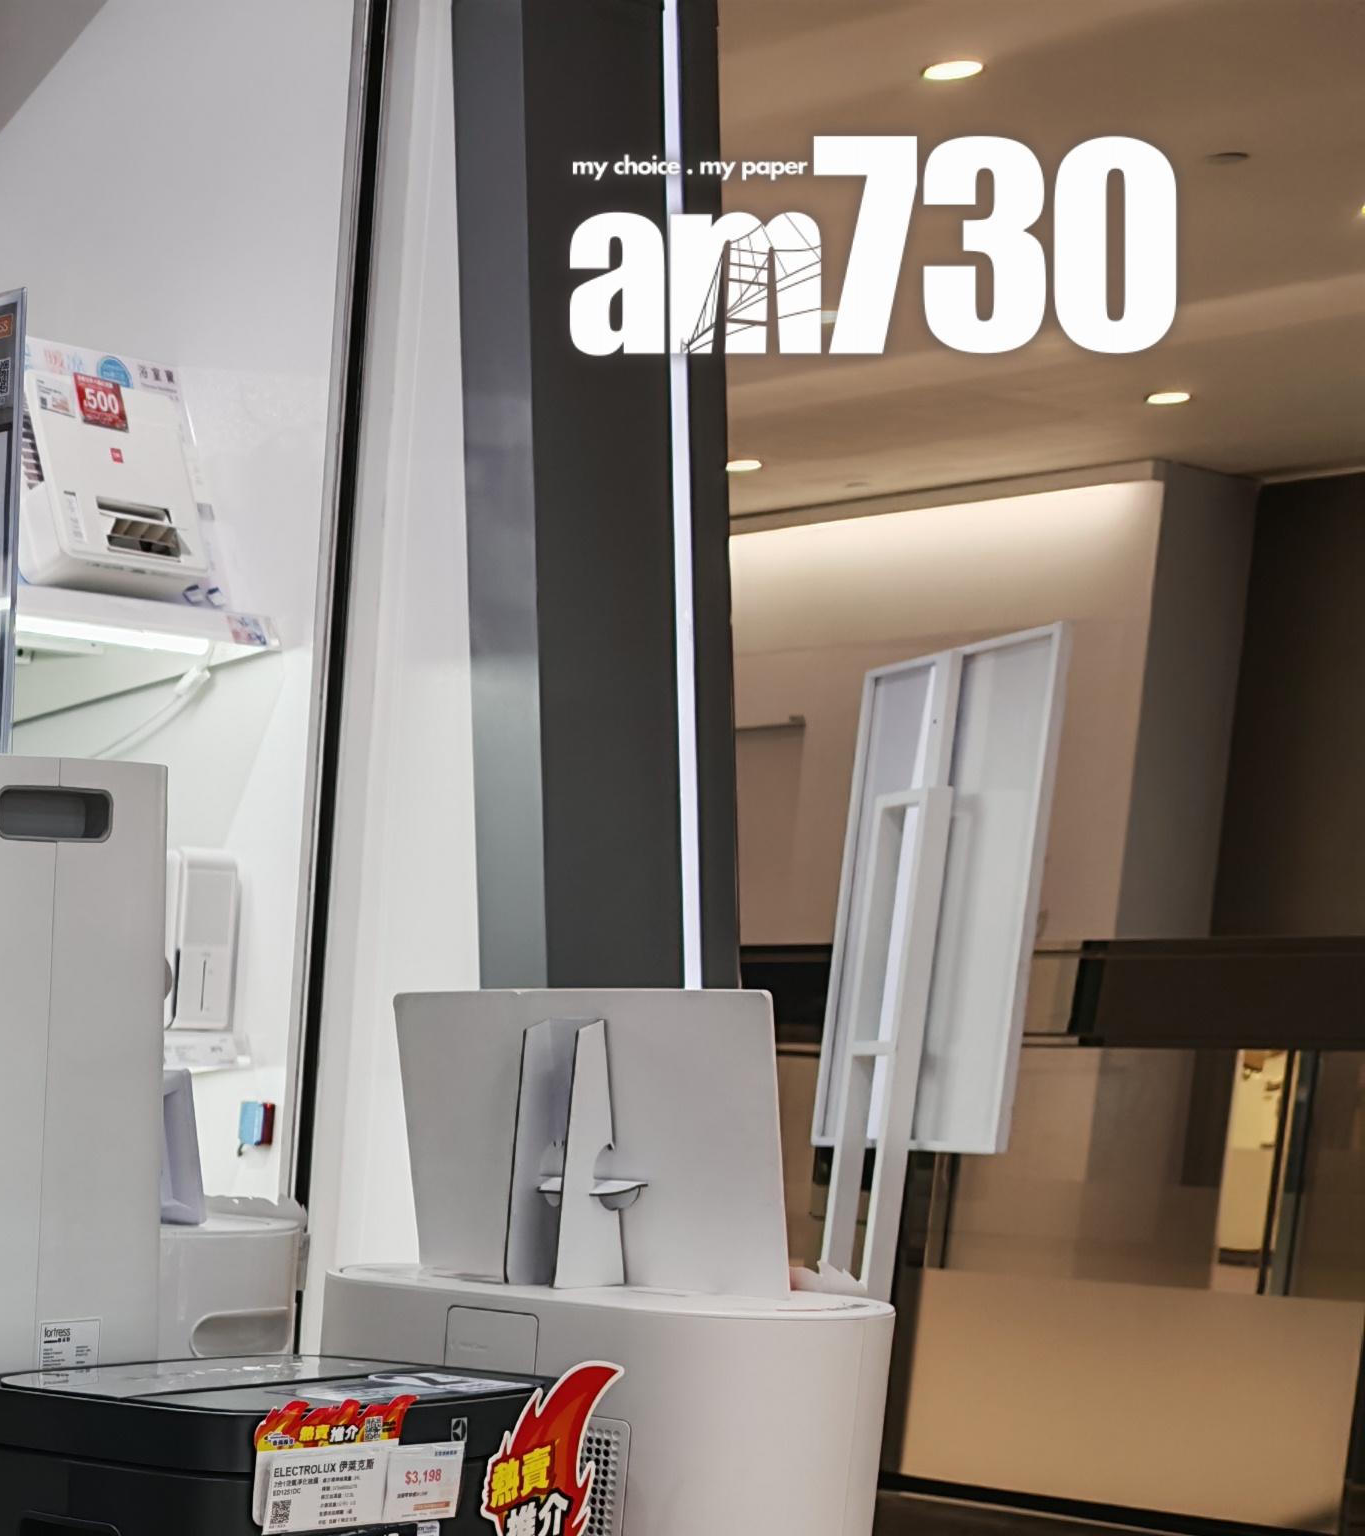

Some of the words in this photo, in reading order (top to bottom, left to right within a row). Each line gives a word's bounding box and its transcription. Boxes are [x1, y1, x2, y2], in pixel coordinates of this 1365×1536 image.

[299, 1424, 358, 1442] 熱賣推介
[274, 1463, 337, 1478] ELECTROLUX
[339, 1458, 374, 1472] 伊萊克斯
[405, 1469, 442, 1485] $3,198
[491, 1447, 556, 1510] 熱賣
